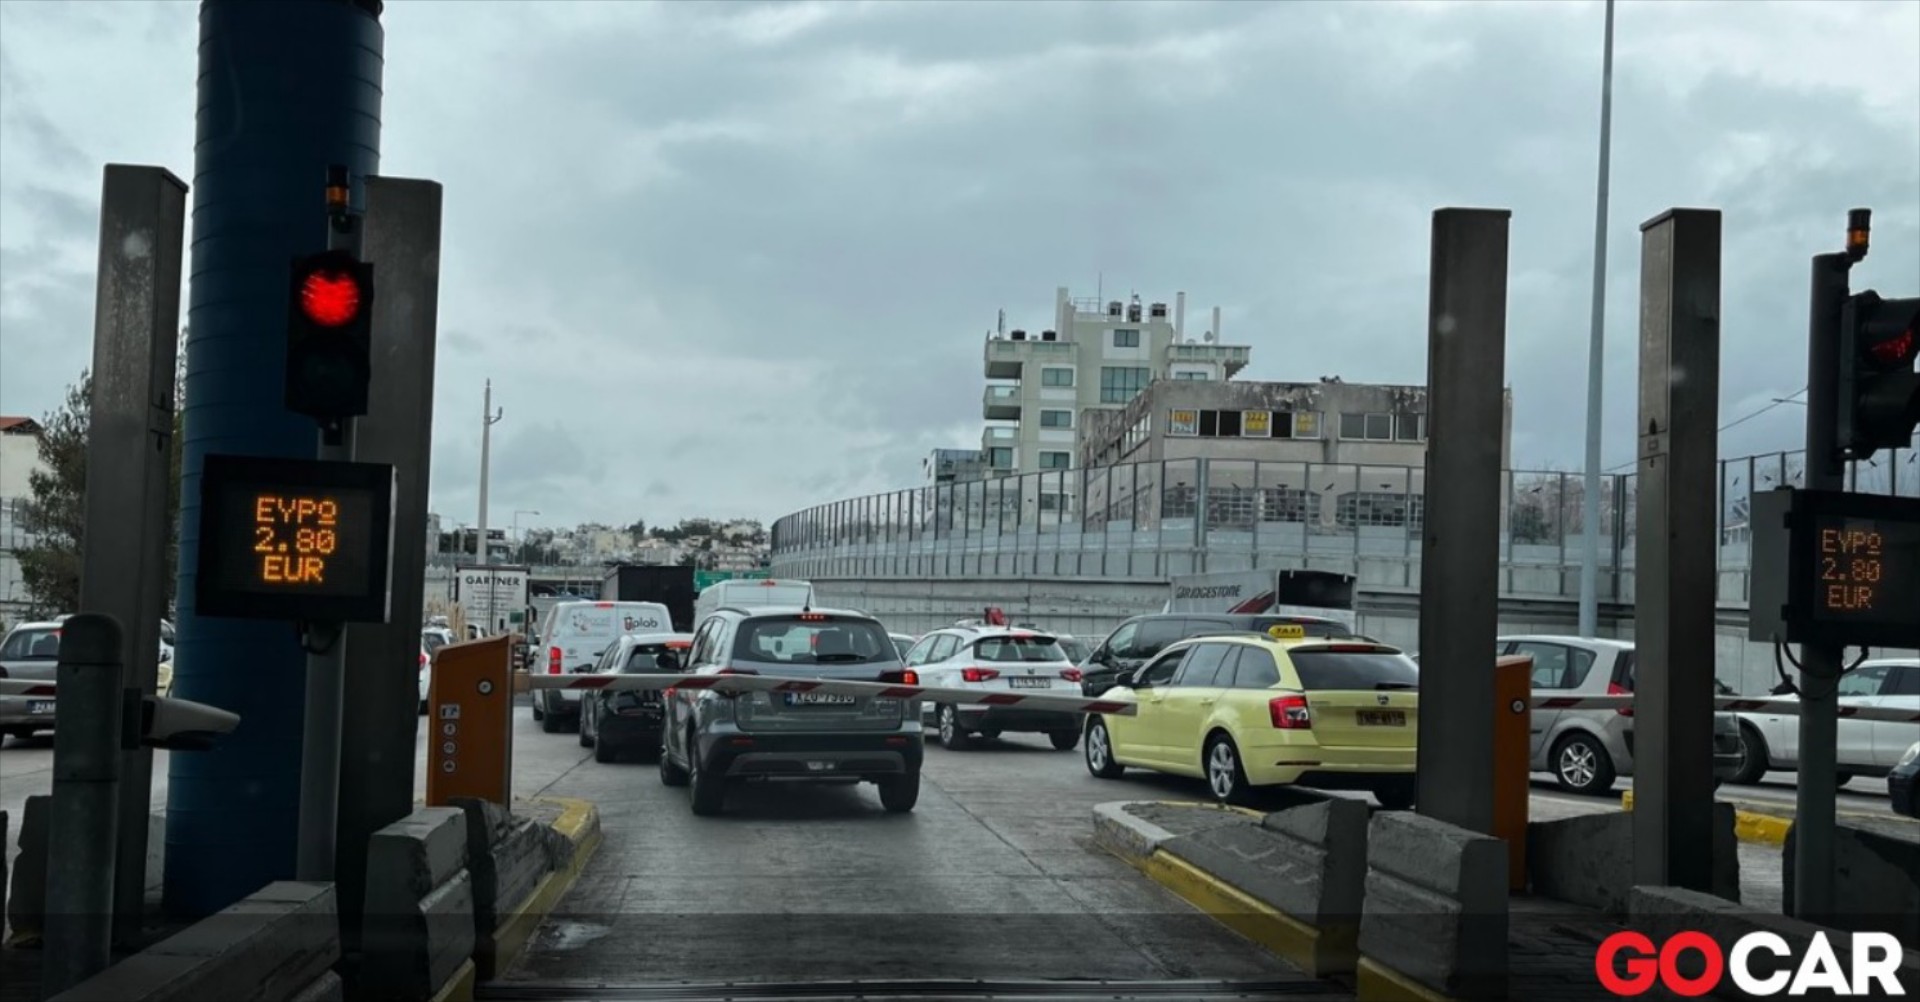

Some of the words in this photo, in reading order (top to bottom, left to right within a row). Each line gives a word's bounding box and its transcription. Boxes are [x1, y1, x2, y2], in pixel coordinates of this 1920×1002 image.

[255, 526, 336, 554] 2.80
[263, 555, 324, 582] EUR
[1821, 557, 1881, 582] 2.80
[1176, 585, 1241, 599] BRIDGESTONE
[1827, 584, 1872, 609] EUR
[1275, 627, 1301, 635] TAXI
